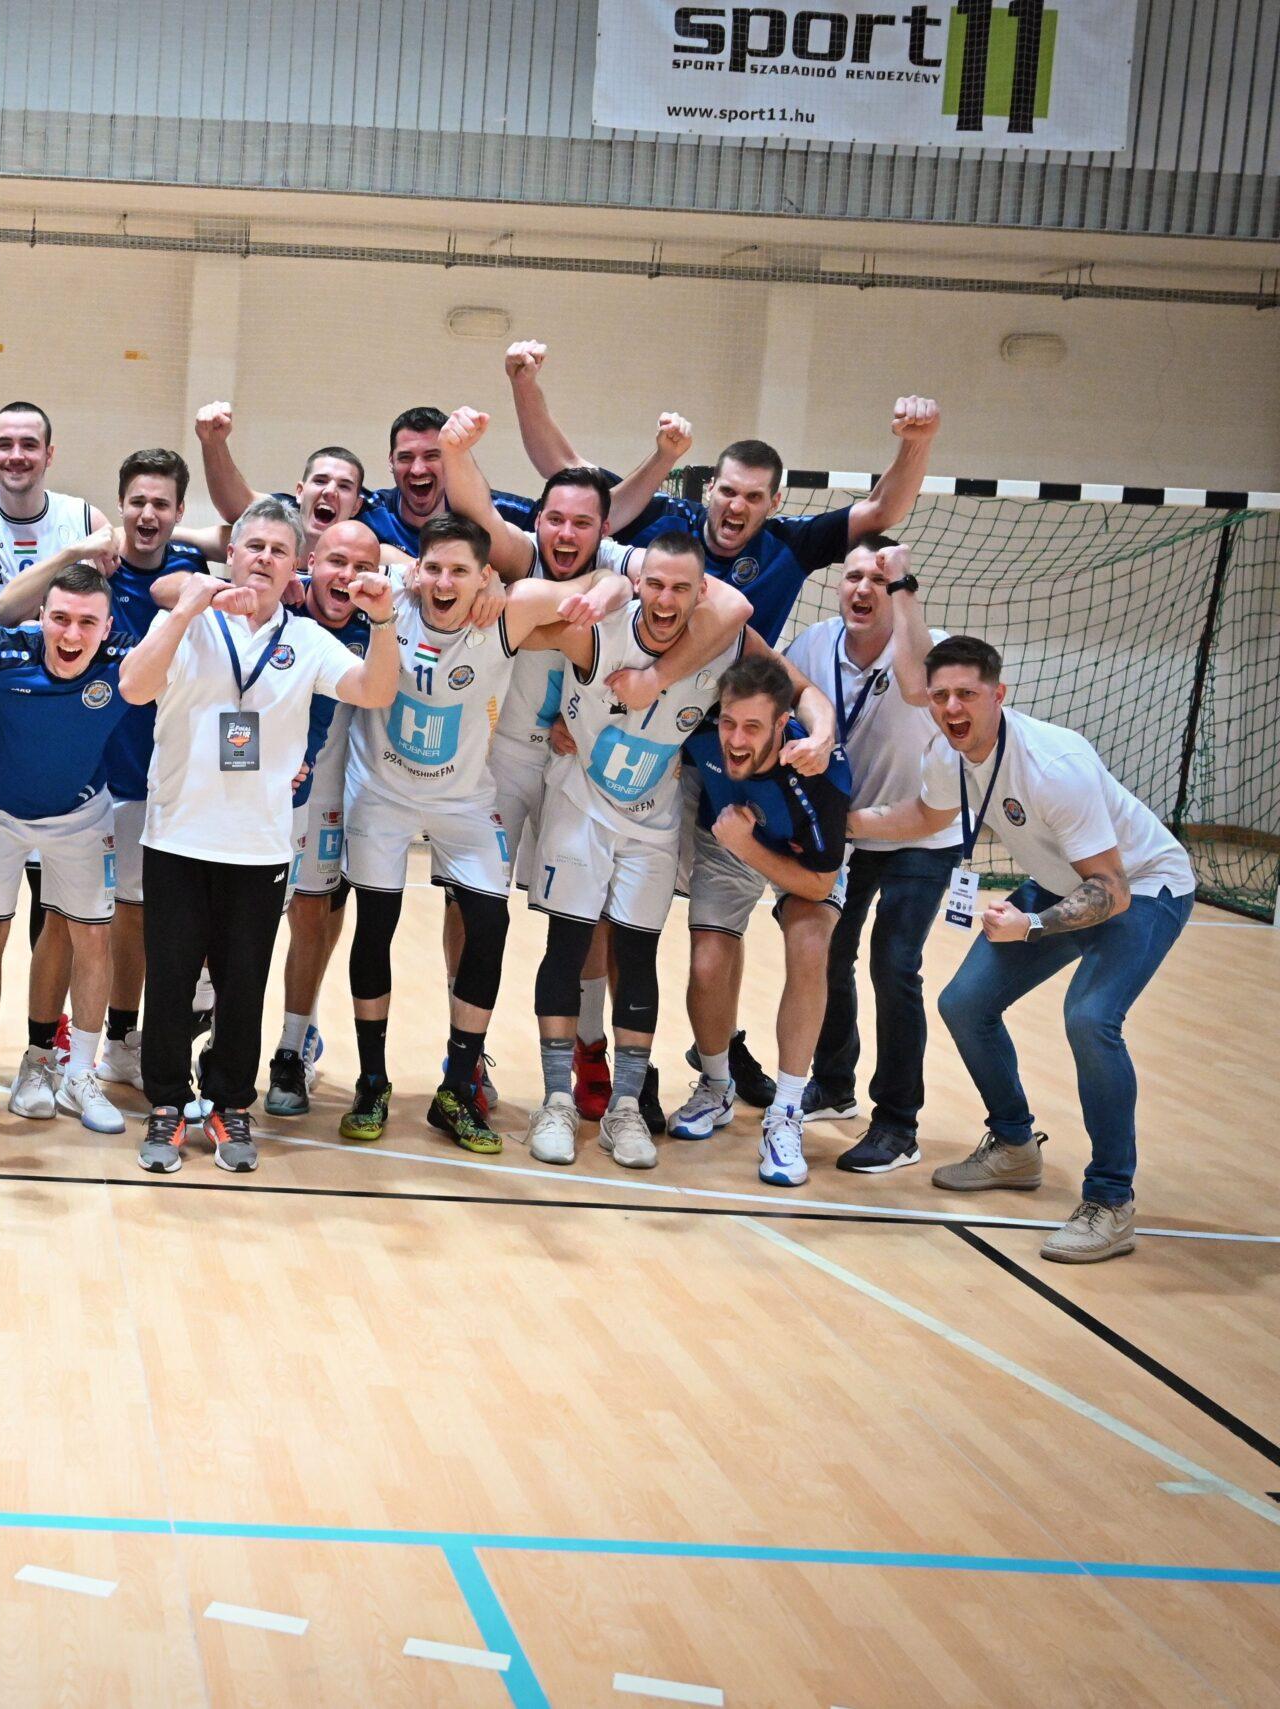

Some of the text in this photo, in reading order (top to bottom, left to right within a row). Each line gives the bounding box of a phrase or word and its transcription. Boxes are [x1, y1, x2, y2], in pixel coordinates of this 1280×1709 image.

[674, 6, 942, 73] sport
[672, 59, 940, 84] SPORT SZABADIDŐ RENDEZVÉNY
[667, 106, 815, 123] www.sport11.hu
[413, 664, 433, 696] 11
[544, 864, 556, 900] 7
